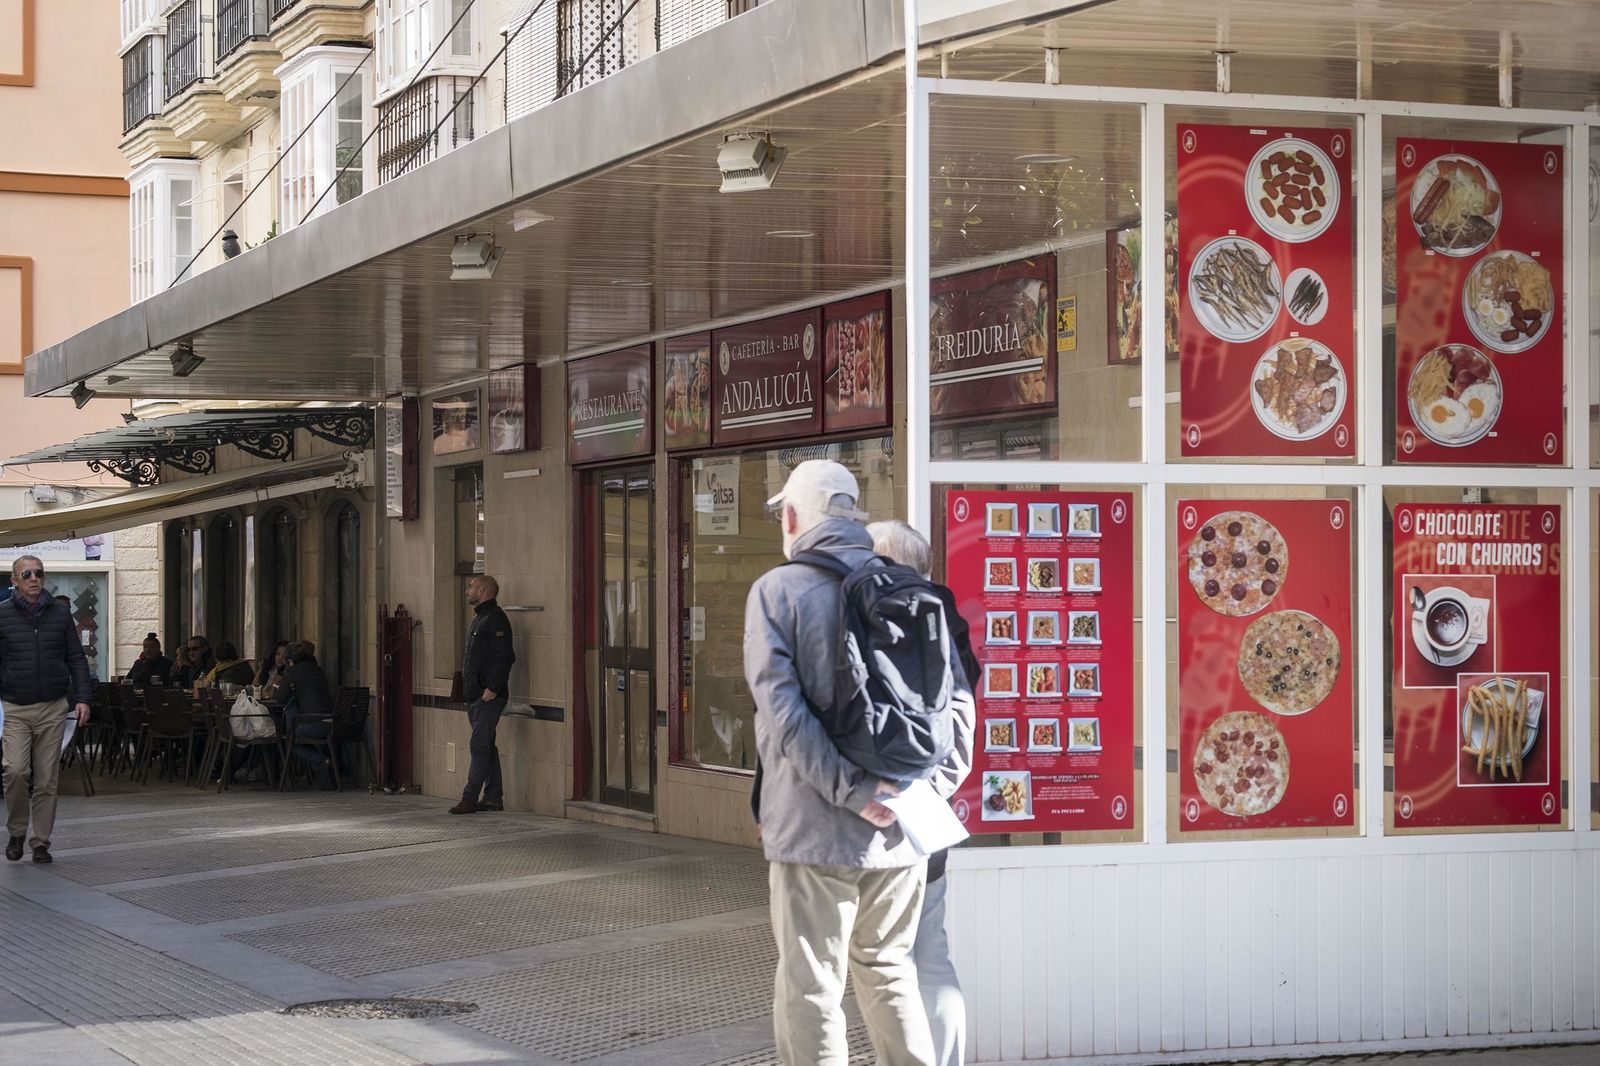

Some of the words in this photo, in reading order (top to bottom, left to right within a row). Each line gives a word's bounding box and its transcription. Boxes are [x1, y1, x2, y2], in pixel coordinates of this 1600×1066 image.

[732, 335, 775, 361] CAFETERÍA
[782, 333, 800, 351] BAR
[936, 313, 1021, 362] FREIDURÍA
[721, 361, 813, 415] ANDALUCÍA
[577, 389, 641, 421] RESTAURANTE
[1416, 512, 1501, 536] CHOCOLATE
[1436, 542, 1467, 566] CON
[1472, 543, 1542, 566] CHURROS
